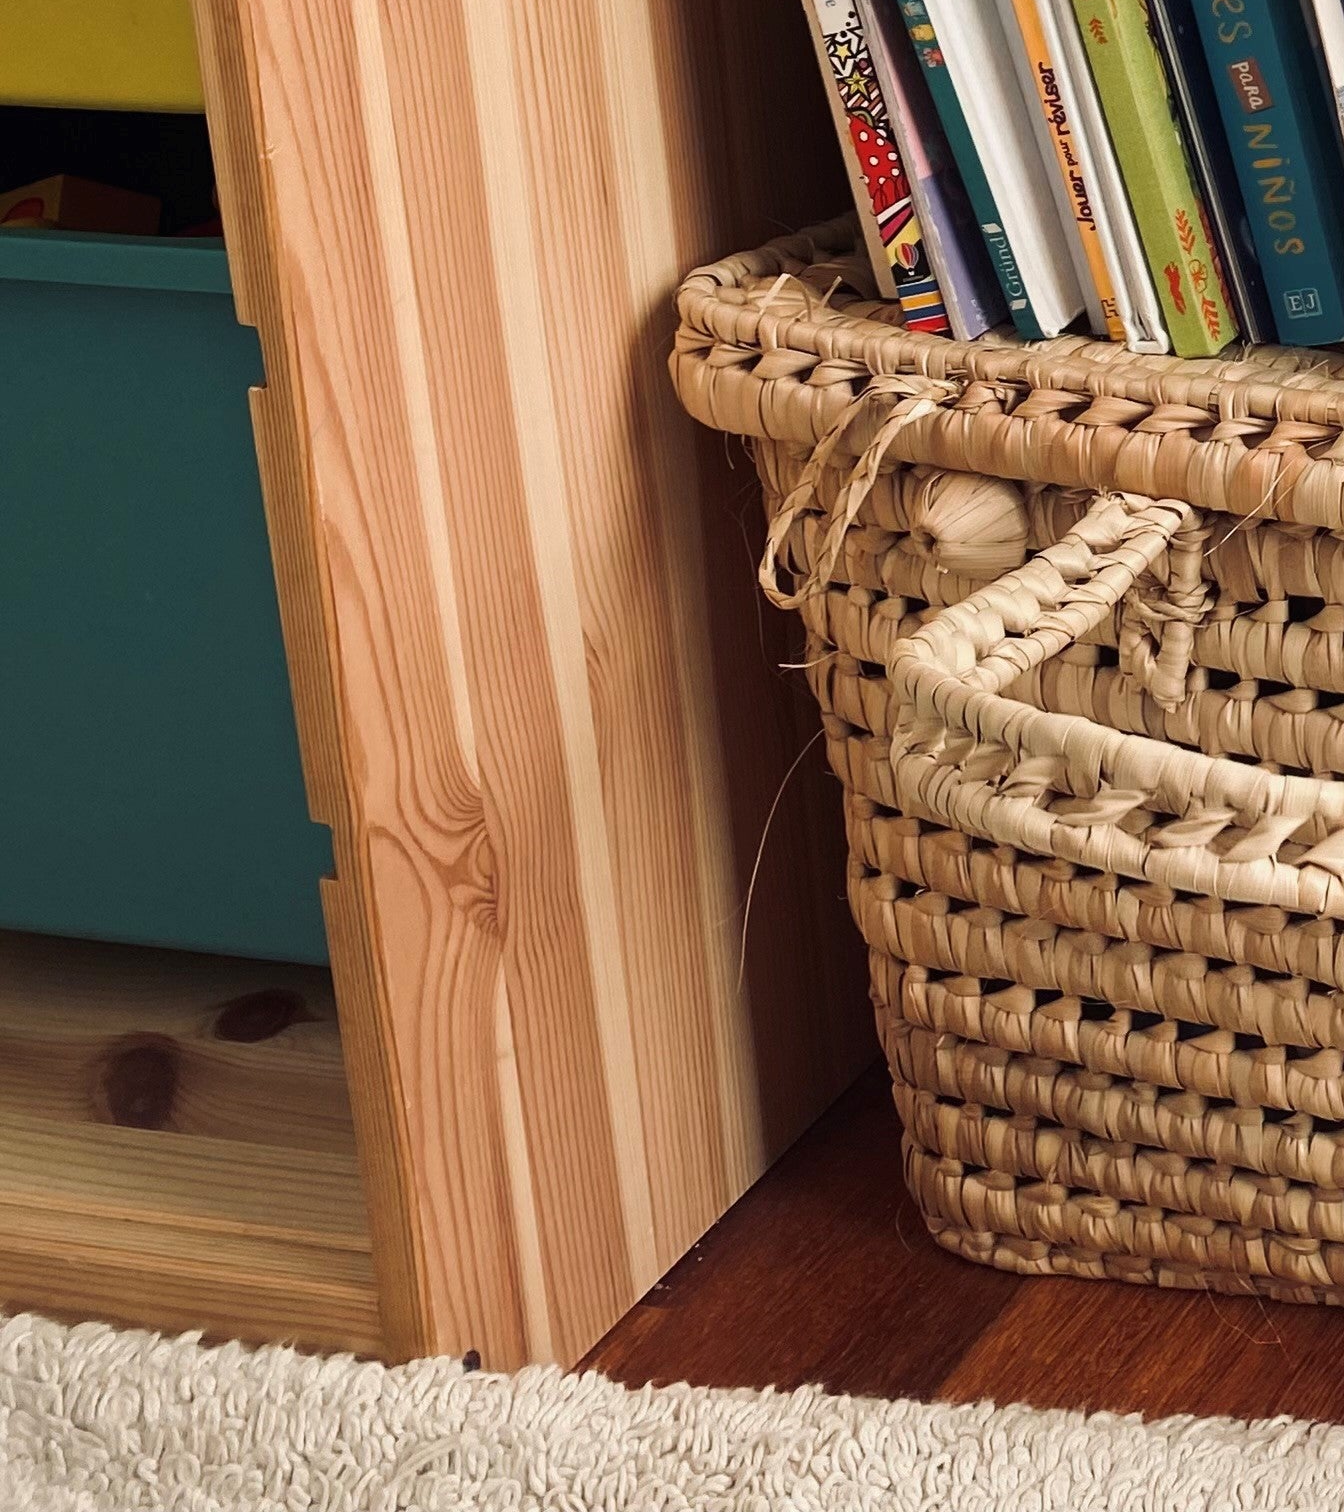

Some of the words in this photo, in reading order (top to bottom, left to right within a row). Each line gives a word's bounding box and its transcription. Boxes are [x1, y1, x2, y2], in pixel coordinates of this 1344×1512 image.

[1037, 61, 1071, 137] réviser
[1059, 138, 1079, 167] pour
[1069, 169, 1097, 232] Jouer
[988, 236, 1024, 298] Gründ
